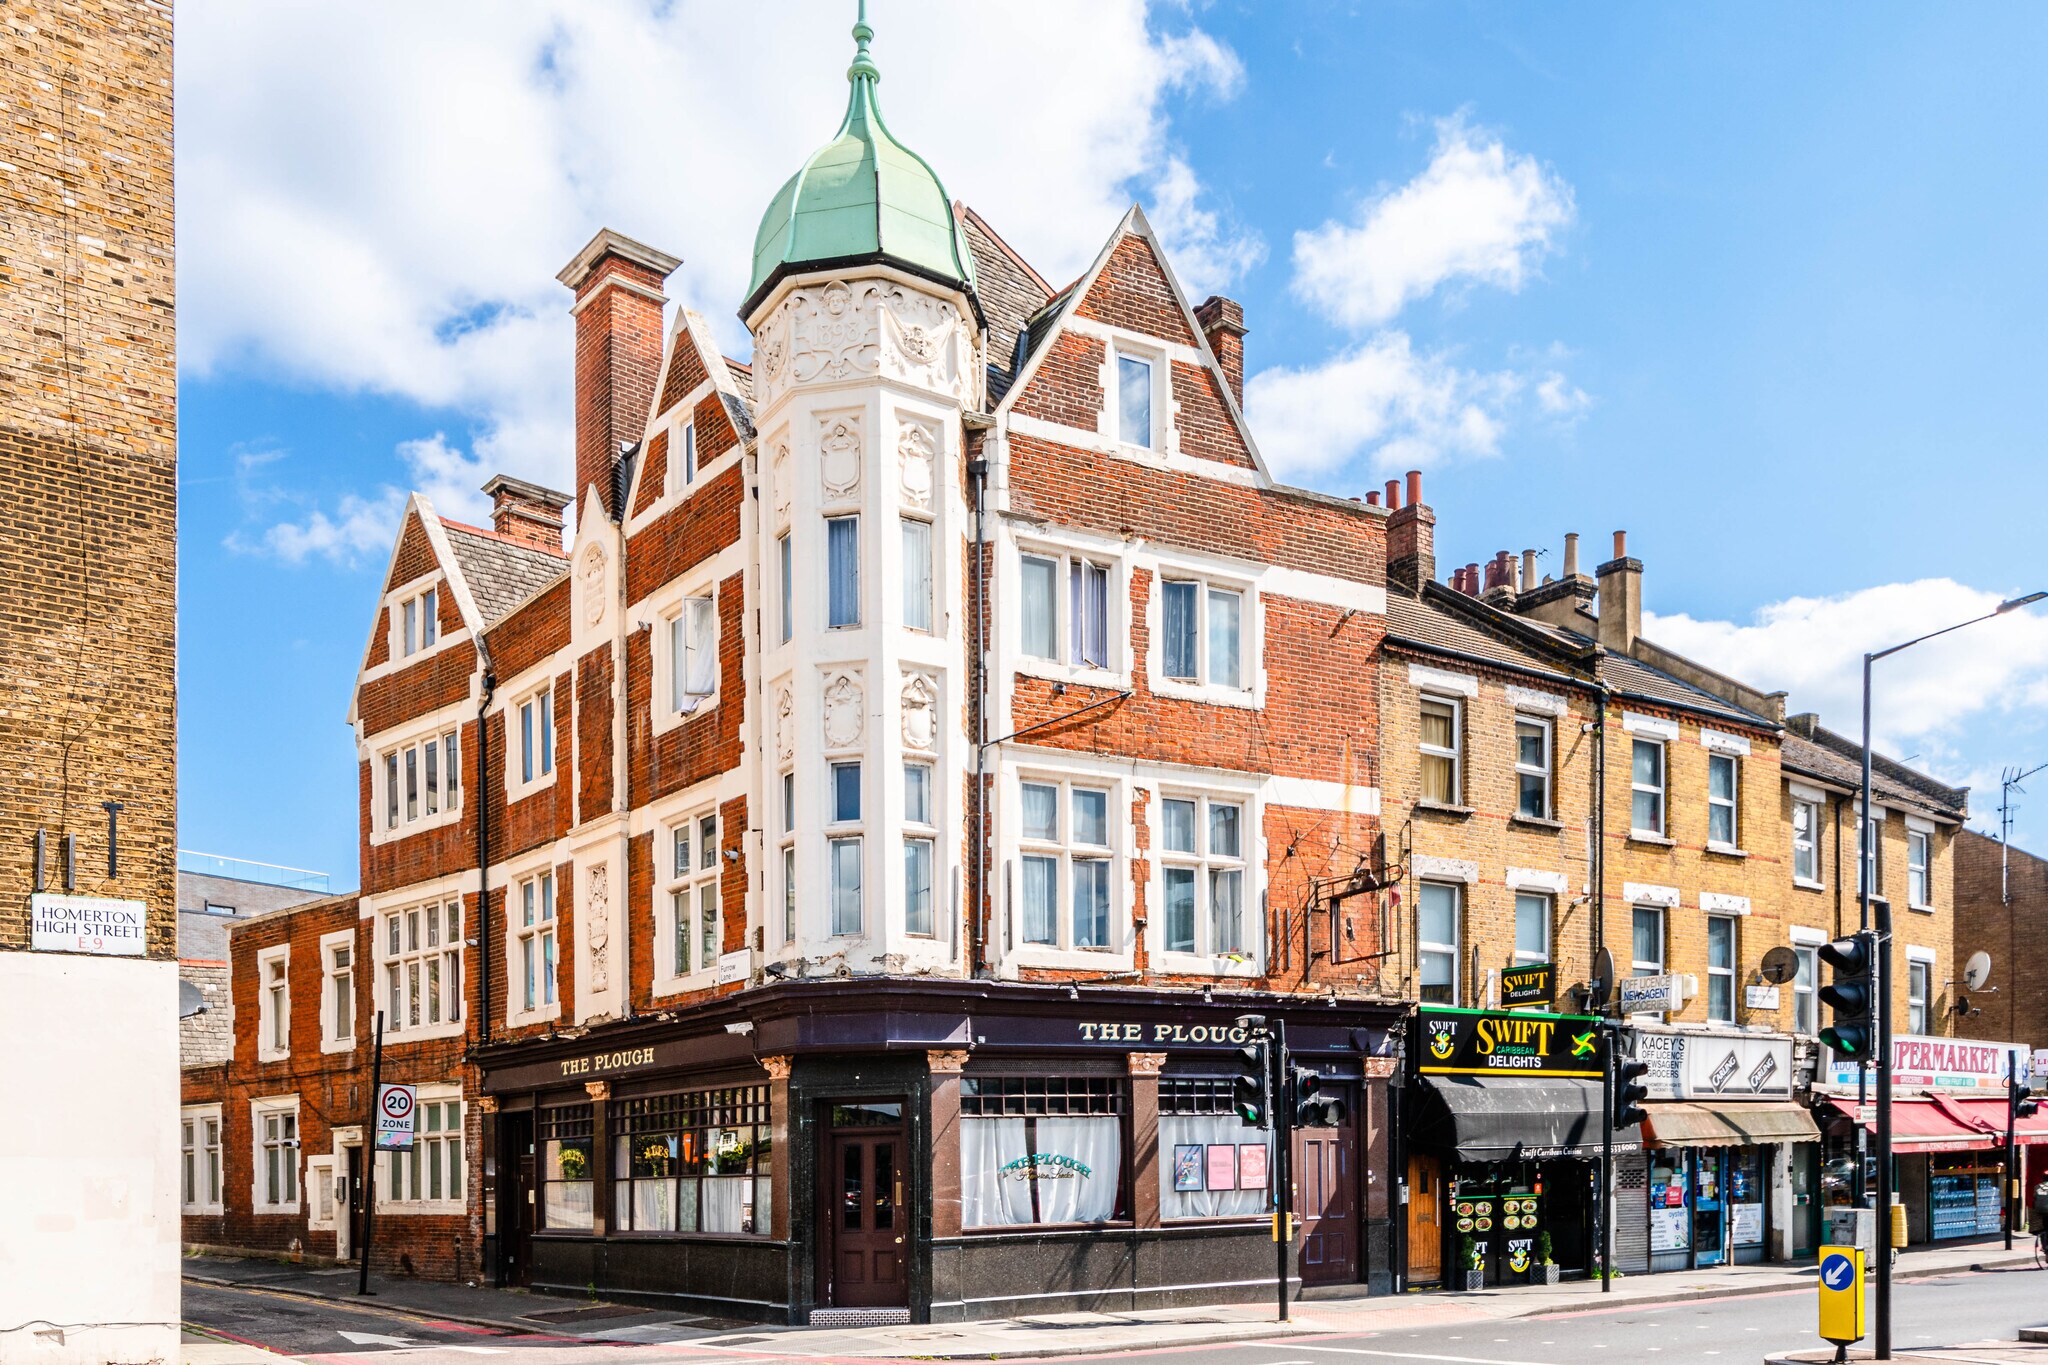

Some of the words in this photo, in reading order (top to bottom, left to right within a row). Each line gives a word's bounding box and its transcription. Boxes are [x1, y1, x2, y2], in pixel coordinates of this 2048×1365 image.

[812, 322, 861, 348] 1898
[42, 907, 136, 924] HOMERTON
[36, 920, 76, 934] HIGH
[84, 923, 142, 939] STREET.
[721, 964, 736, 973] Furrow
[721, 973, 731, 982] Lane
[1503, 971, 1548, 993] SWIFT
[1624, 979, 1638, 990] OFF
[1640, 976, 1670, 989] LICENCE
[1510, 988, 1541, 998] DELIGHTS
[1624, 988, 1669, 1001] NEWSAGENT
[1624, 999, 1670, 1012] GROCERIES
[1078, 1022, 1142, 1042] THE
[1429, 1020, 1457, 1035] SWIFT
[1476, 1018, 1554, 1056] SWIFT
[1642, 1037, 1685, 1051] KACEY'S
[1496, 1045, 1535, 1055] CARIBBEAN
[1642, 1050, 1654, 1059] OFF
[1657, 1051, 1684, 1060] LICENCE
[561, 1058, 589, 1075] THE
[594, 1047, 655, 1071] PLOUGH
[1488, 1055, 1542, 1068] DELIGHTS
[1891, 1041, 1999, 1074] UPERMARKET
[1647, 1070, 1679, 1078] GROCERS
[1712, 1056, 1736, 1087] CARLING
[1750, 1057, 1774, 1087] CARLING
[387, 1096, 408, 1109] 20
[382, 1120, 410, 1128] ZONE
[1520, 1147, 1537, 1159] Swift
[1563, 1146, 1582, 1155] Cuisine
[1621, 1143, 1637, 1151] 6060
[998, 1154, 1031, 1179] THE
[1032, 1153, 1092, 1179] PLOUGH
[1668, 1210, 1686, 1219] oyster
[1508, 1239, 1533, 1252] SWIFT
